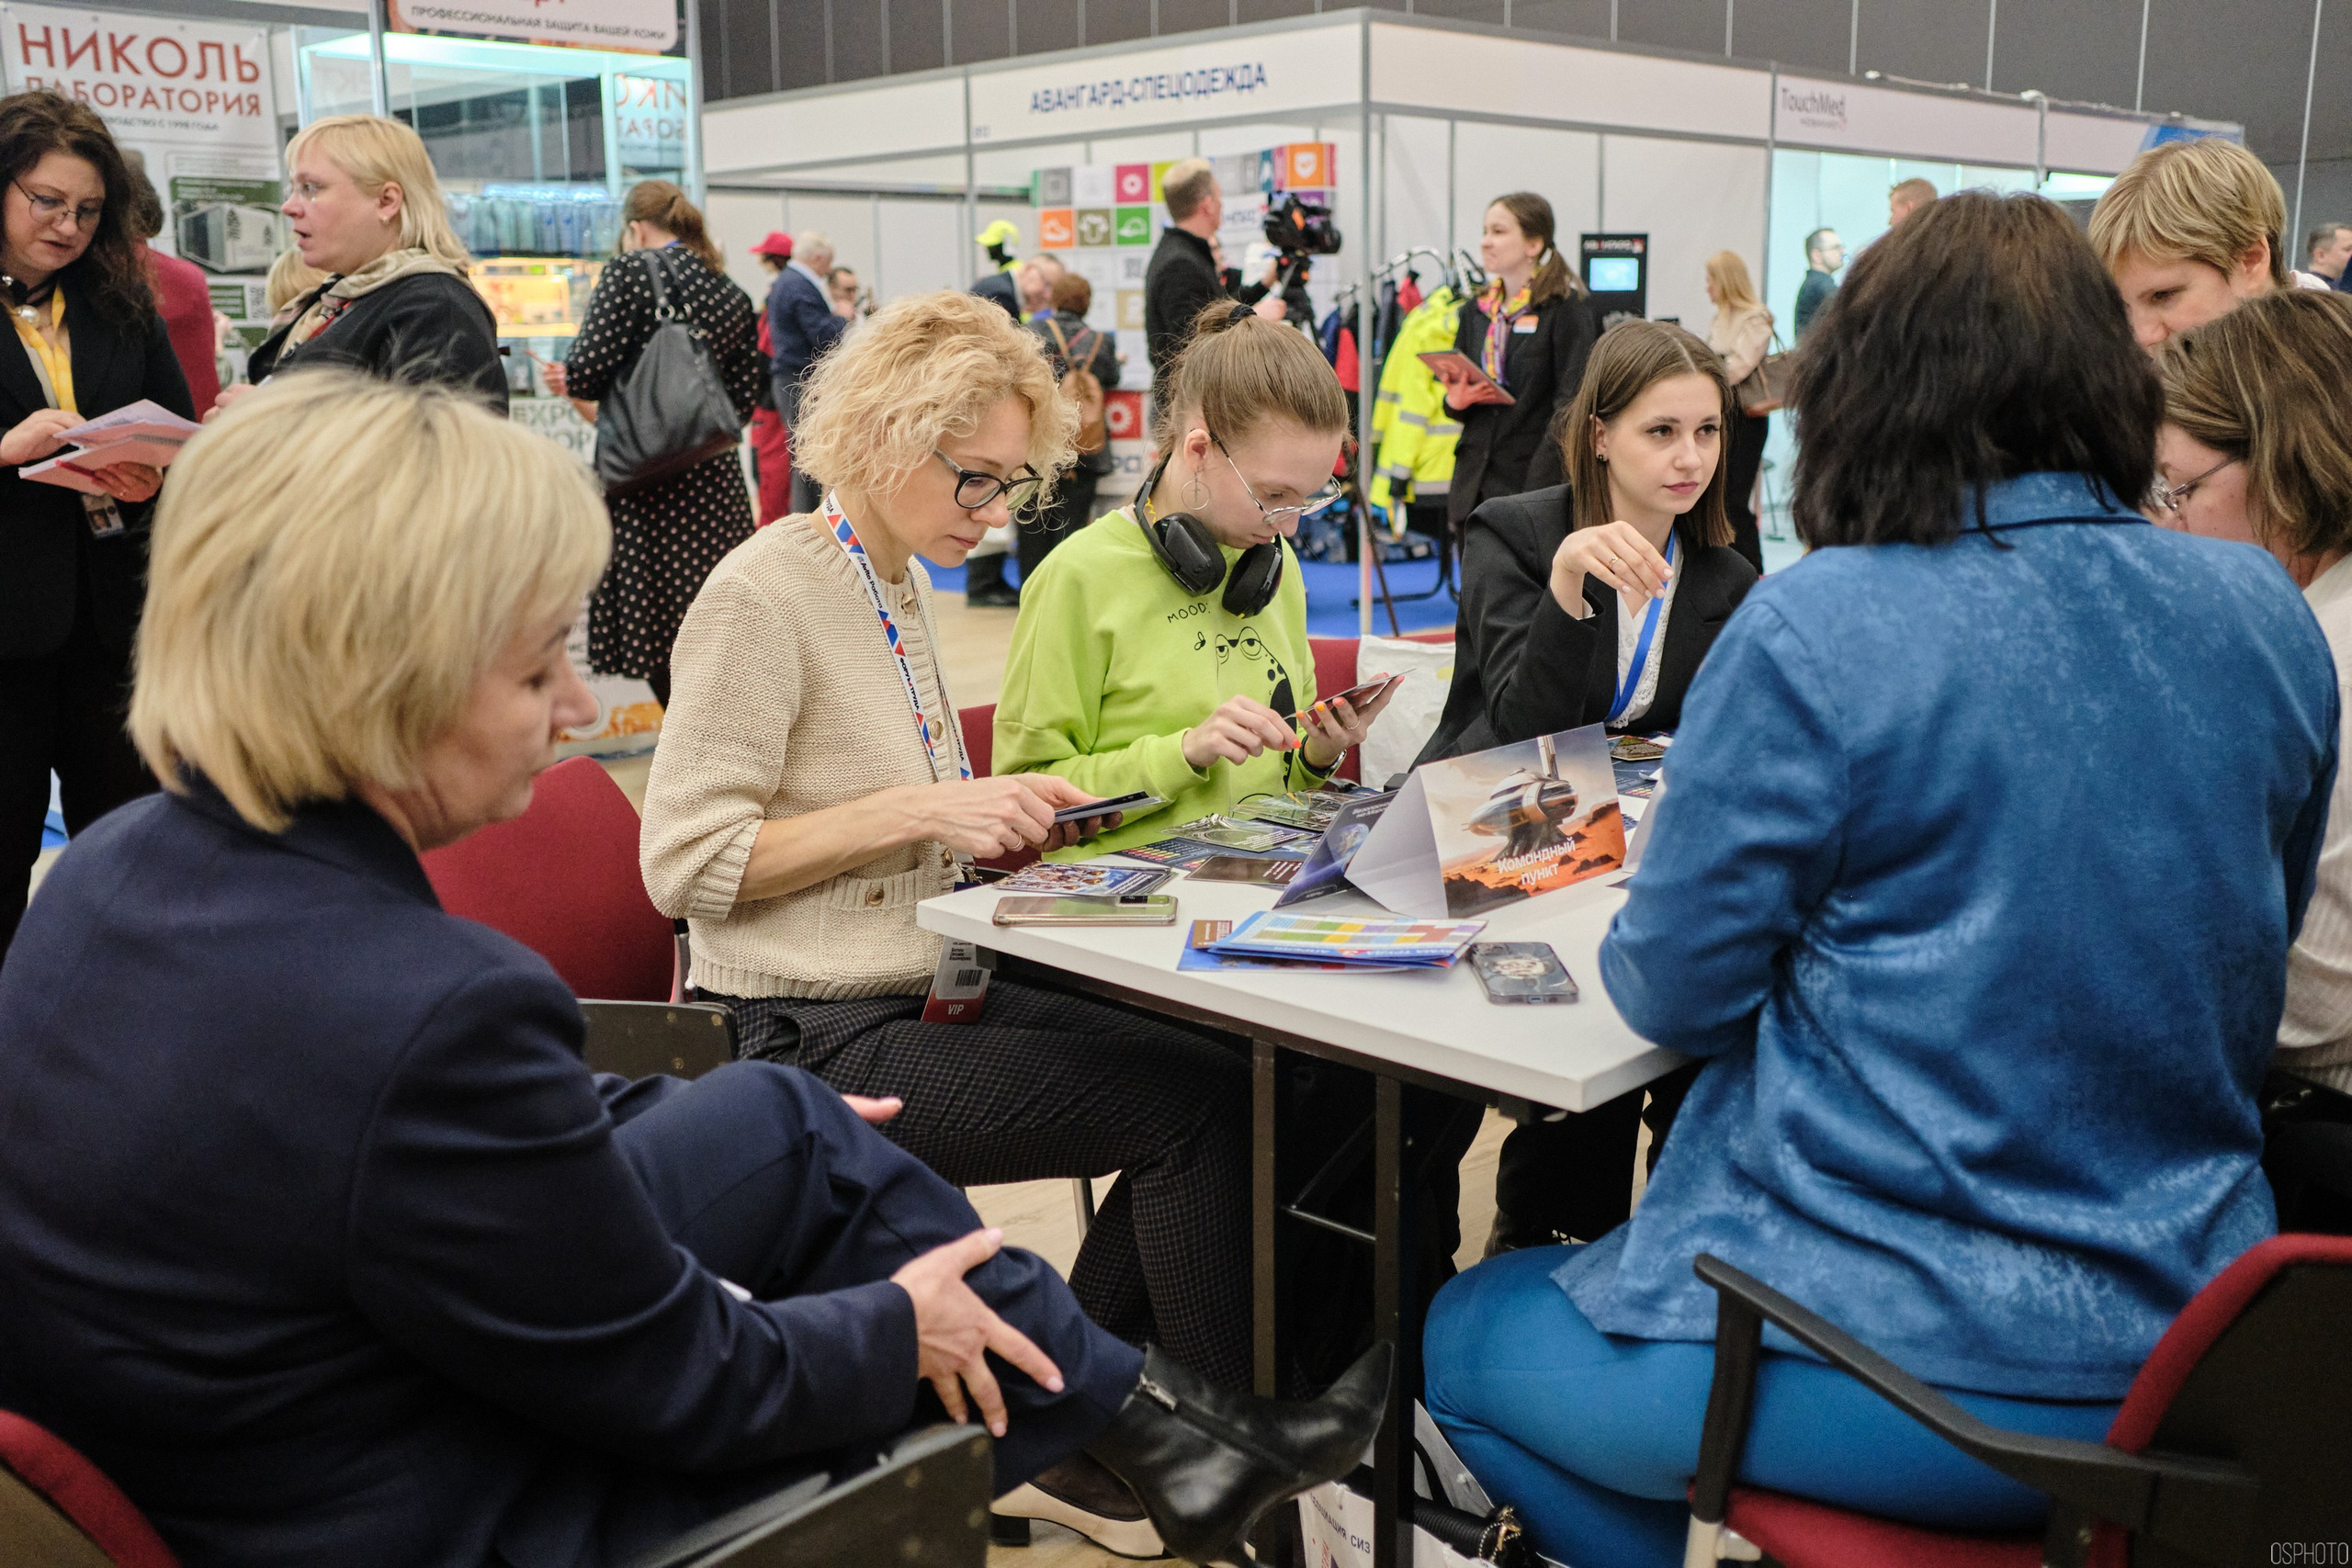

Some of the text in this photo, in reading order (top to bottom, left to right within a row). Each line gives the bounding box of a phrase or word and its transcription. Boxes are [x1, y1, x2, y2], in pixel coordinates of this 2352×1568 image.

[411, 6, 542, 28] ПРОФЕССИОНАЛЬНАЯ
[545, 18, 591, 33] ЗАЩИТА
[17, 22, 261, 84] НИКОЛЬ
[1029, 62, 1268, 114] АВАНГАРД-СПЕЦОДЕЖДА
[1781, 87, 1846, 118] TouchMed
[860, 562, 883, 608] Avito Работа
[1498, 836, 1577, 874] Командный
[1521, 863, 1559, 886] пункт
[947, 1004, 964, 1015] VIP
[1351, 1534, 1371, 1554] СИЗ
